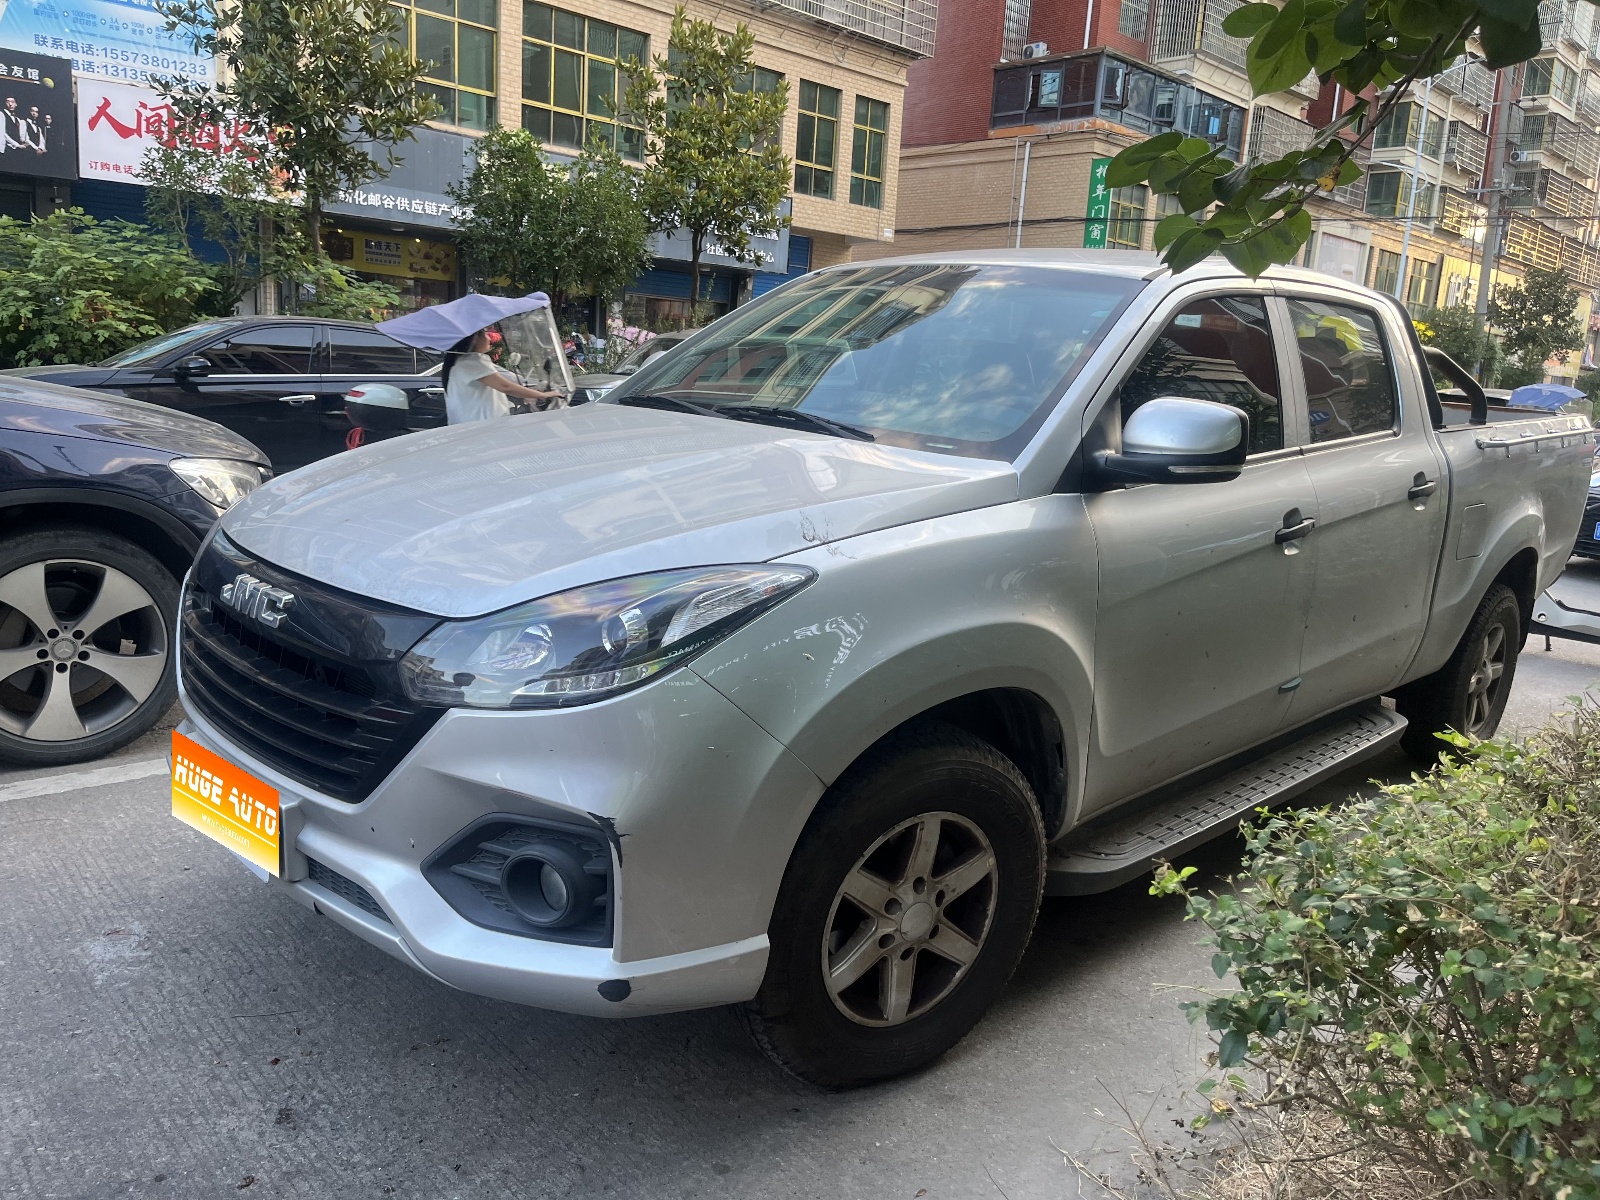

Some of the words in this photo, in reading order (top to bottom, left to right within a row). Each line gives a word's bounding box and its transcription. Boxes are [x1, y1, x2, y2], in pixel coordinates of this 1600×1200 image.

[34, 33, 207, 76] 联系电话:15573801233
[220, 573, 295, 629] JMC
